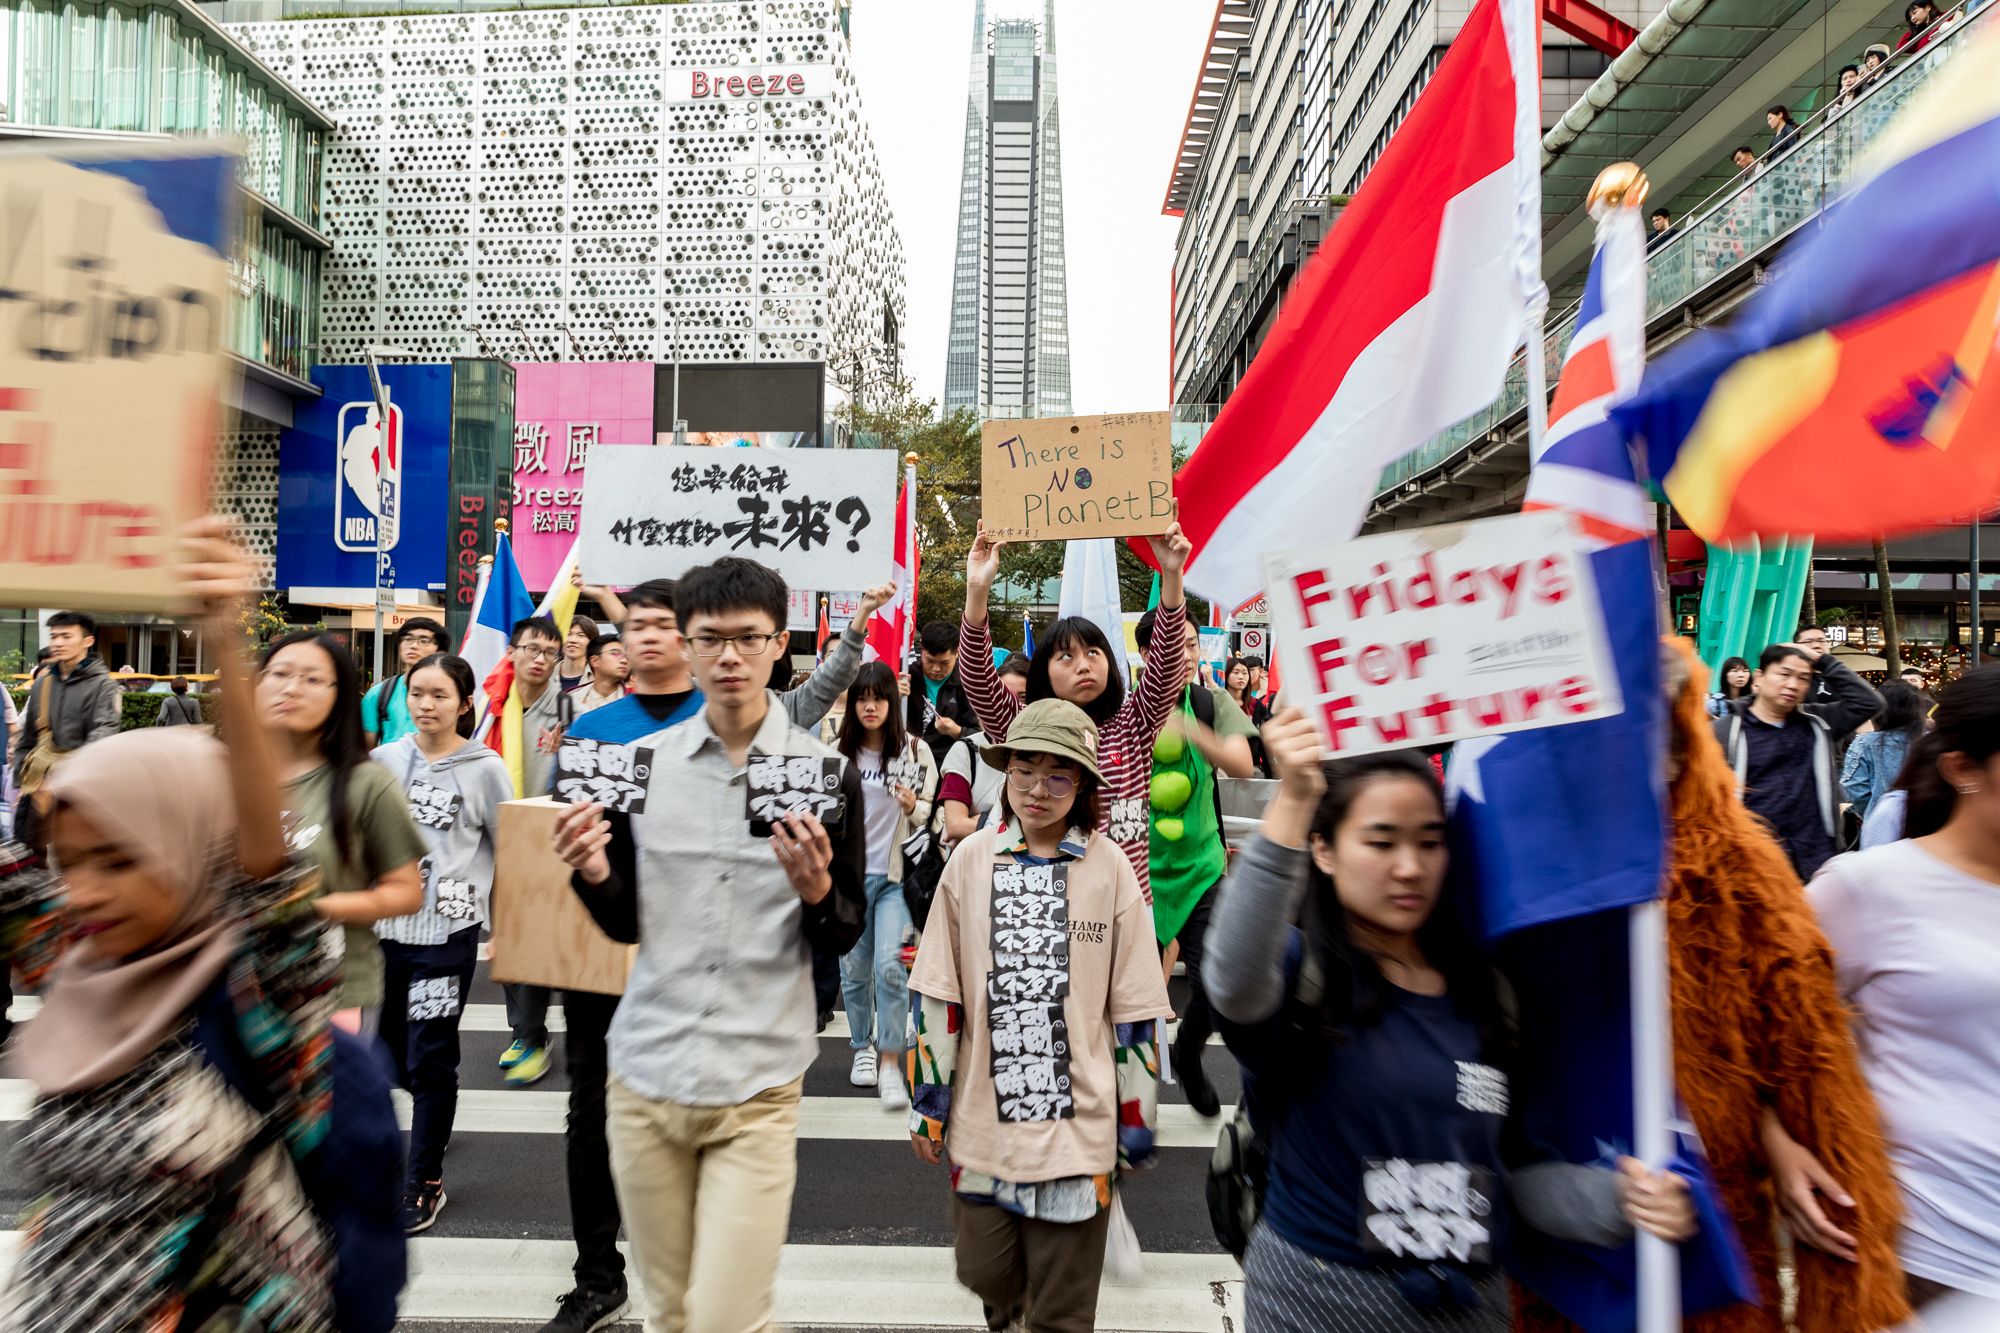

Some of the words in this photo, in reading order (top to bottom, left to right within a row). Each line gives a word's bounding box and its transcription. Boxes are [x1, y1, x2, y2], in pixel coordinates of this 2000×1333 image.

[691, 71, 804, 97] Breeze
[514, 421, 600, 475] 微風
[997, 434, 1079, 468] There
[1100, 437, 1124, 460] is
[513, 483, 583, 507] Breez
[1024, 491, 1142, 528] Planet
[1148, 480, 1172, 517] B
[345, 517, 376, 541] NBA
[532, 510, 577, 533] 松高
[380, 552, 391, 575] P
[457, 495, 485, 604] Breeze
[1289, 551, 1578, 630] Fridays
[1686, 615, 1695, 630] 3
[1305, 636, 1438, 694] For
[1317, 674, 1601, 752] Future
